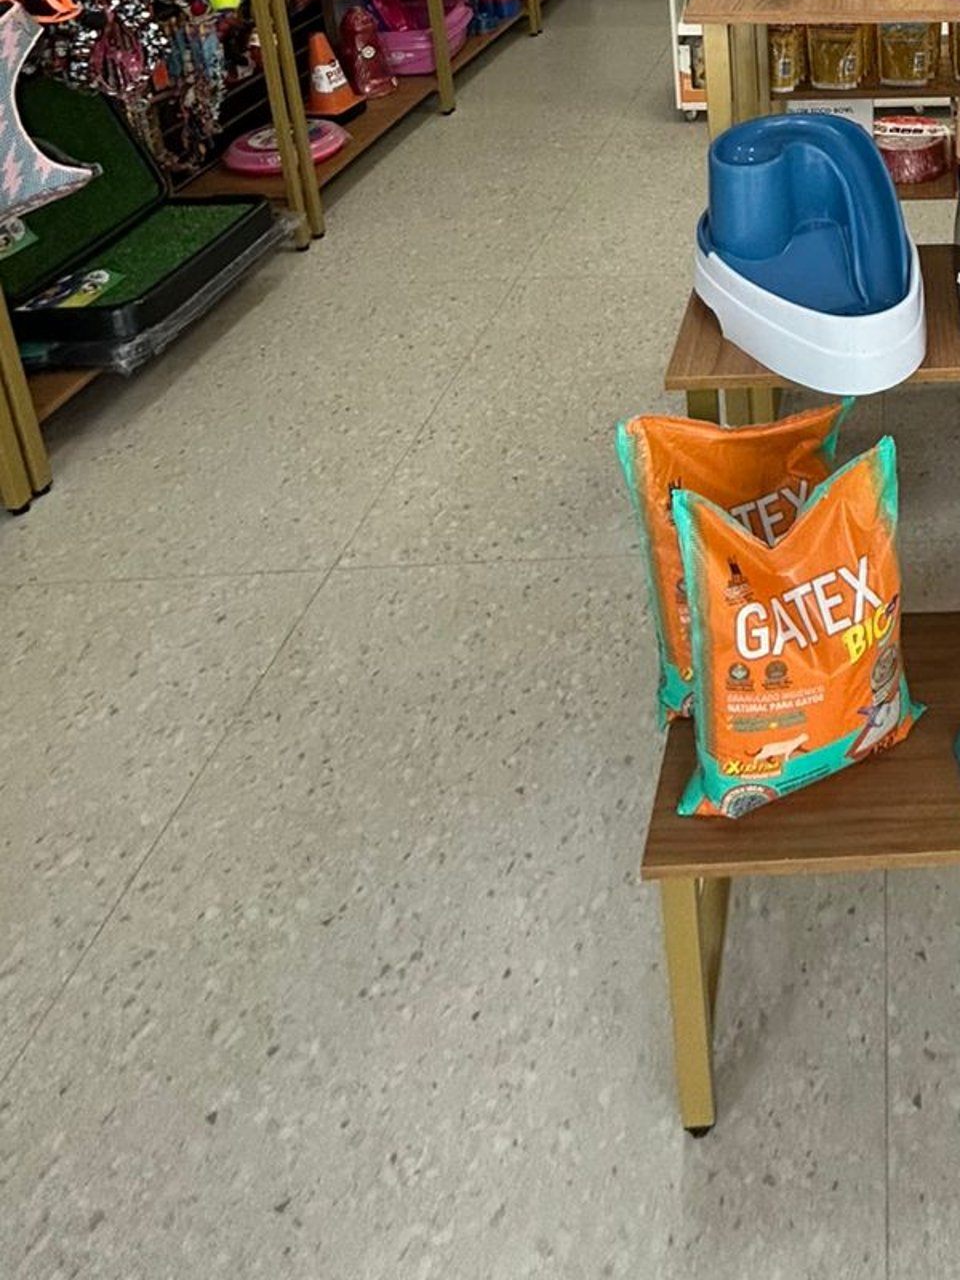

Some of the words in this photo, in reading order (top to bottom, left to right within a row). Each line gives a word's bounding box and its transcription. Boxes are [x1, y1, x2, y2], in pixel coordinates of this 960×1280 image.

[730, 479, 808, 547] TEX
[735, 555, 882, 660] GATEX
[727, 703, 768, 713] NATURAL
